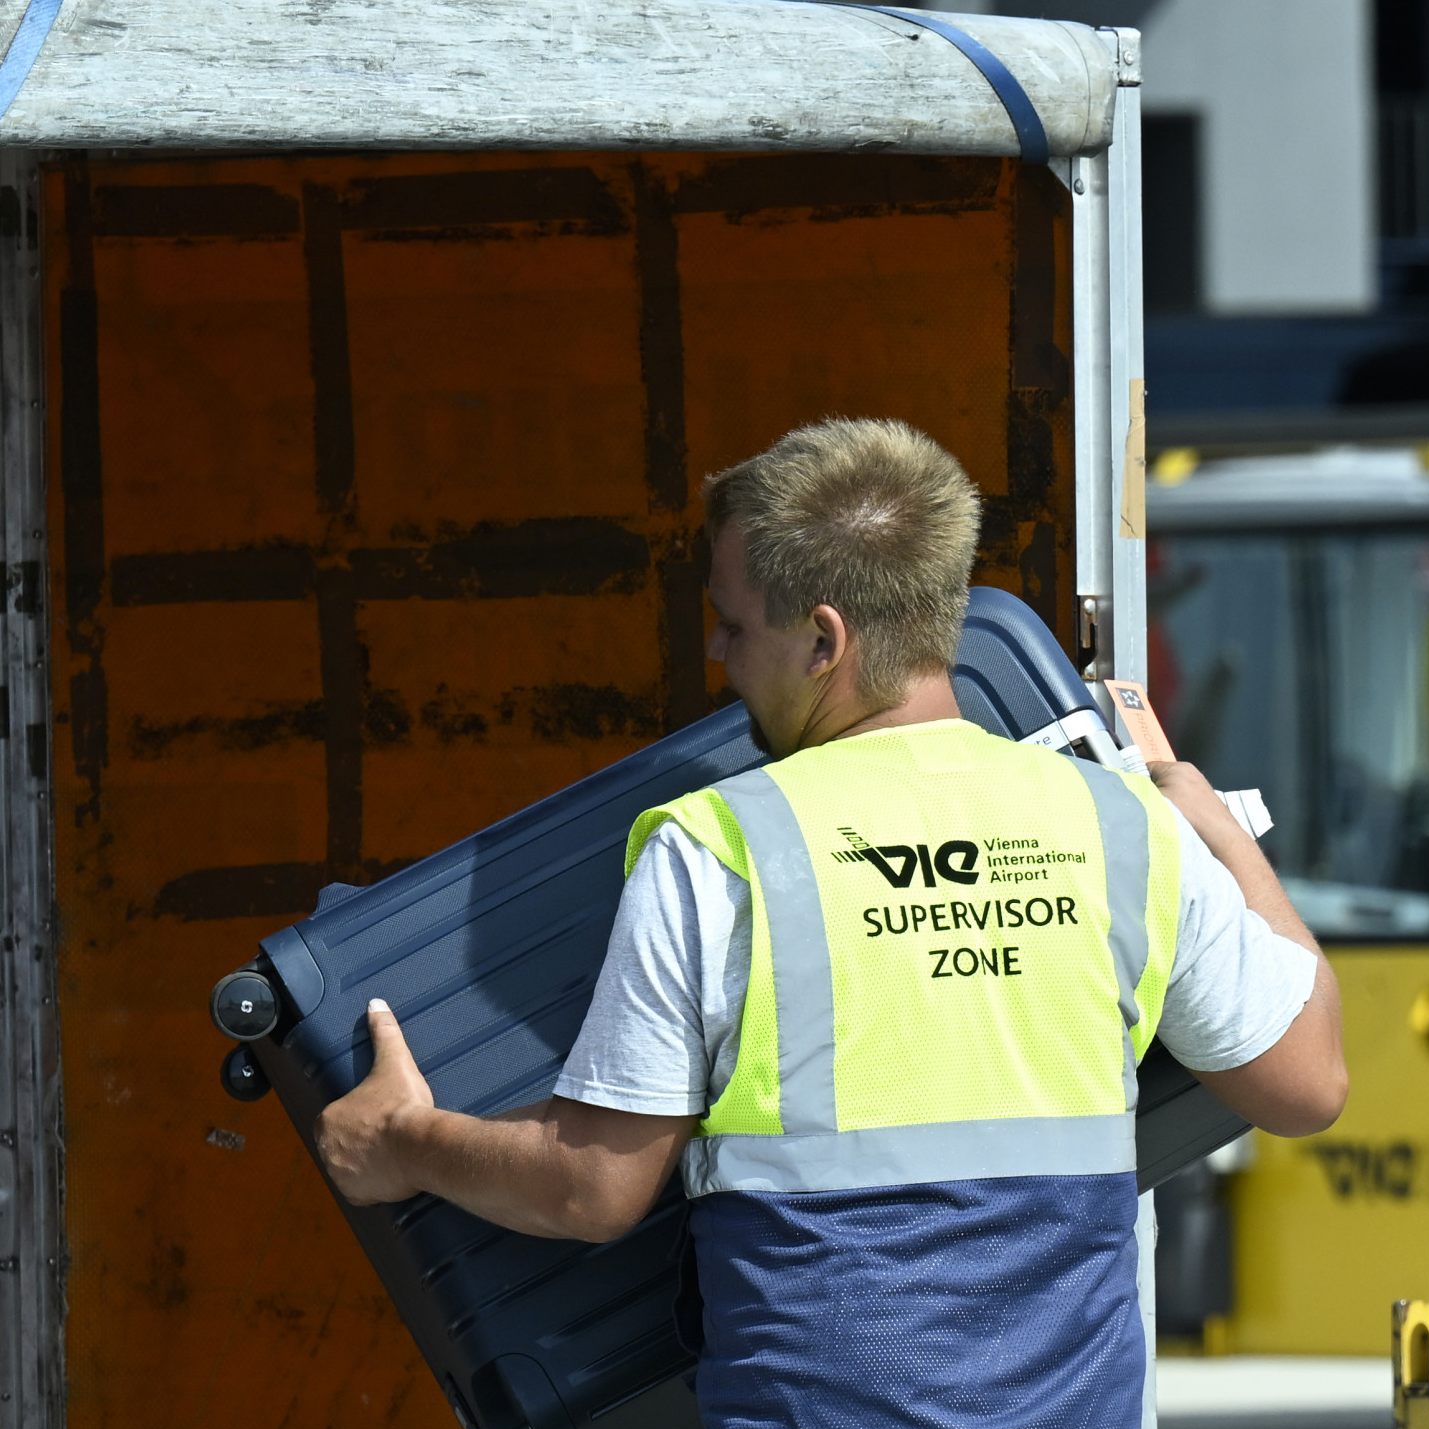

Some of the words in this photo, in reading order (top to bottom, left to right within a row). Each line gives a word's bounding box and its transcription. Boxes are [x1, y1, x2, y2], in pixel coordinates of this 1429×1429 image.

[984, 838, 1040, 852] Vienna
[986, 851, 1087, 868] International
[990, 868, 1049, 885] Airport
[862, 896, 1079, 938] SUPERVISOR
[928, 946, 1023, 979] ZONE
